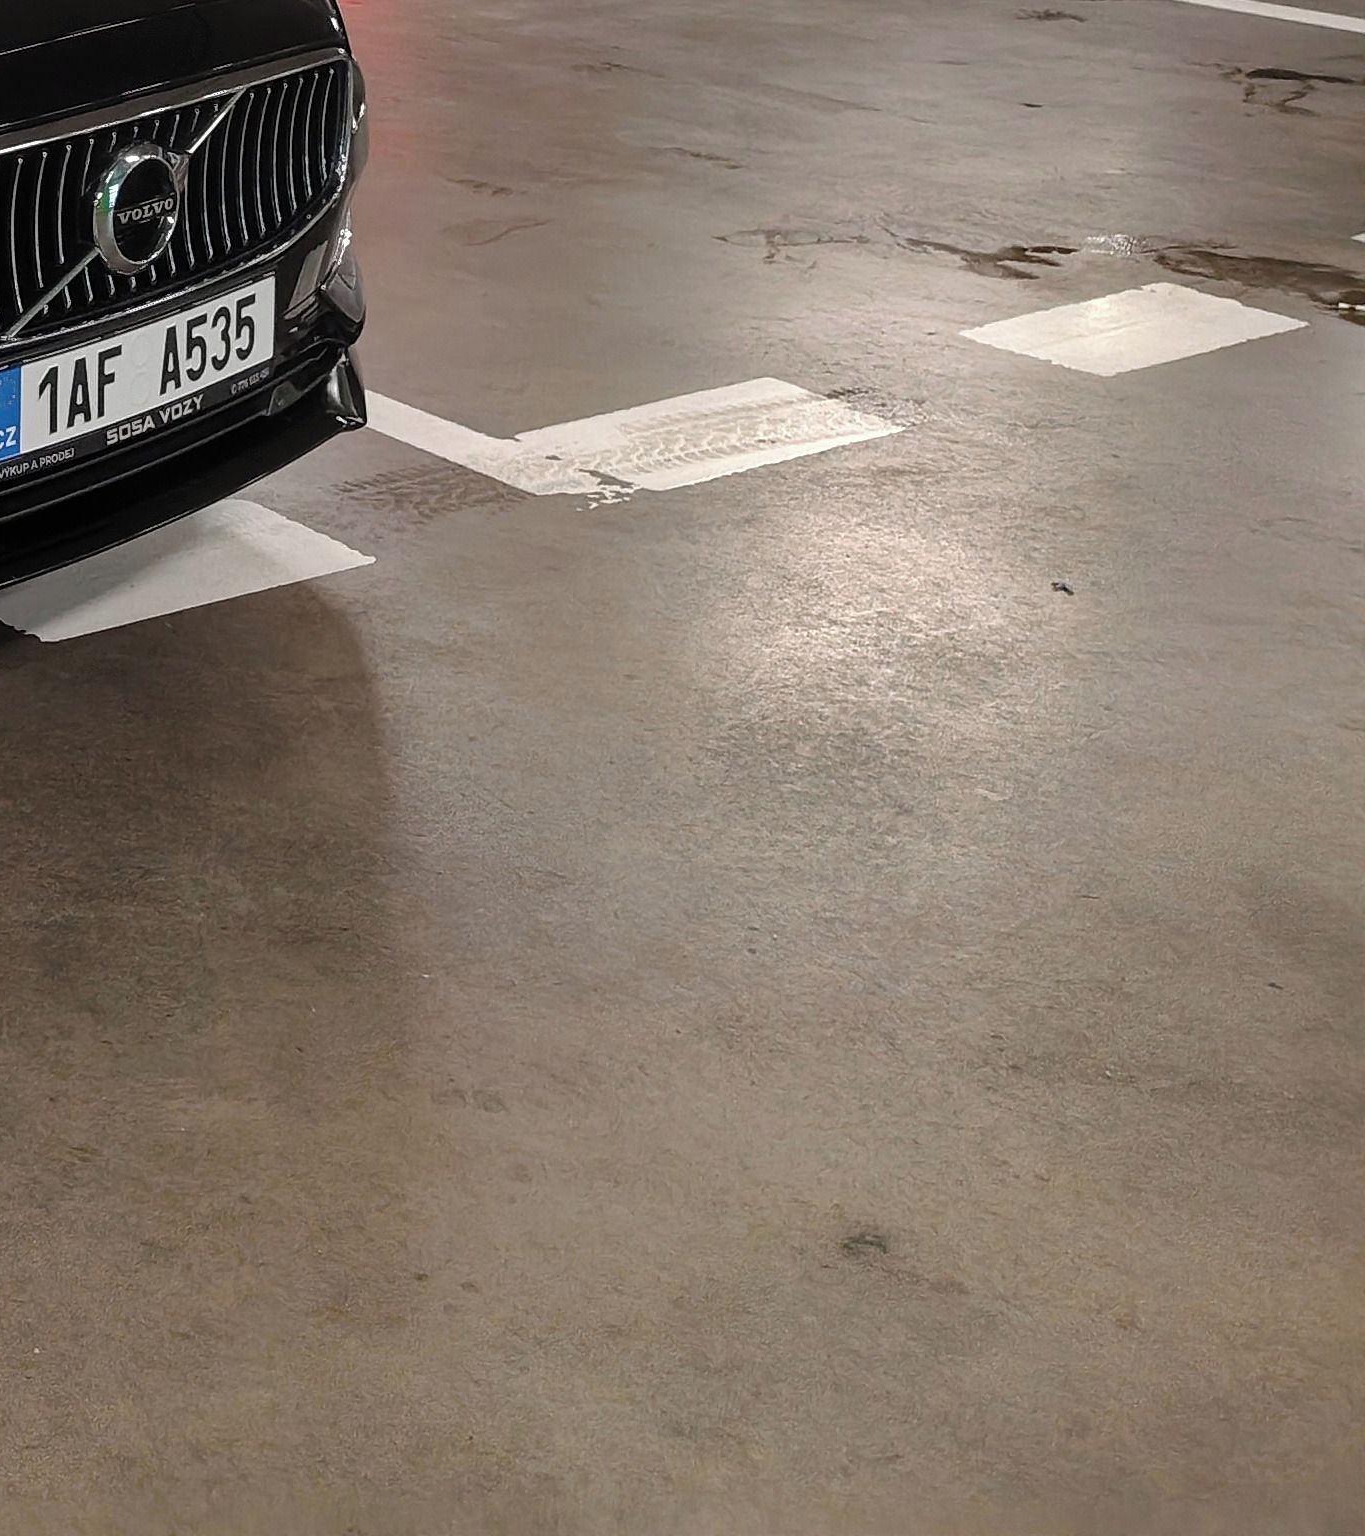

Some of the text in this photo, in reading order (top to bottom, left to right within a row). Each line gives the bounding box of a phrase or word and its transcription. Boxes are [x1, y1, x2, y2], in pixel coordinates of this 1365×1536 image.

[116, 197, 175, 225] VOLVO
[37, 343, 122, 435] 1AF
[158, 292, 257, 396] A535
[106, 393, 204, 446] SOSA VOZY
[31, 459, 39, 470] A
[40, 447, 75, 468] PRODEJ
